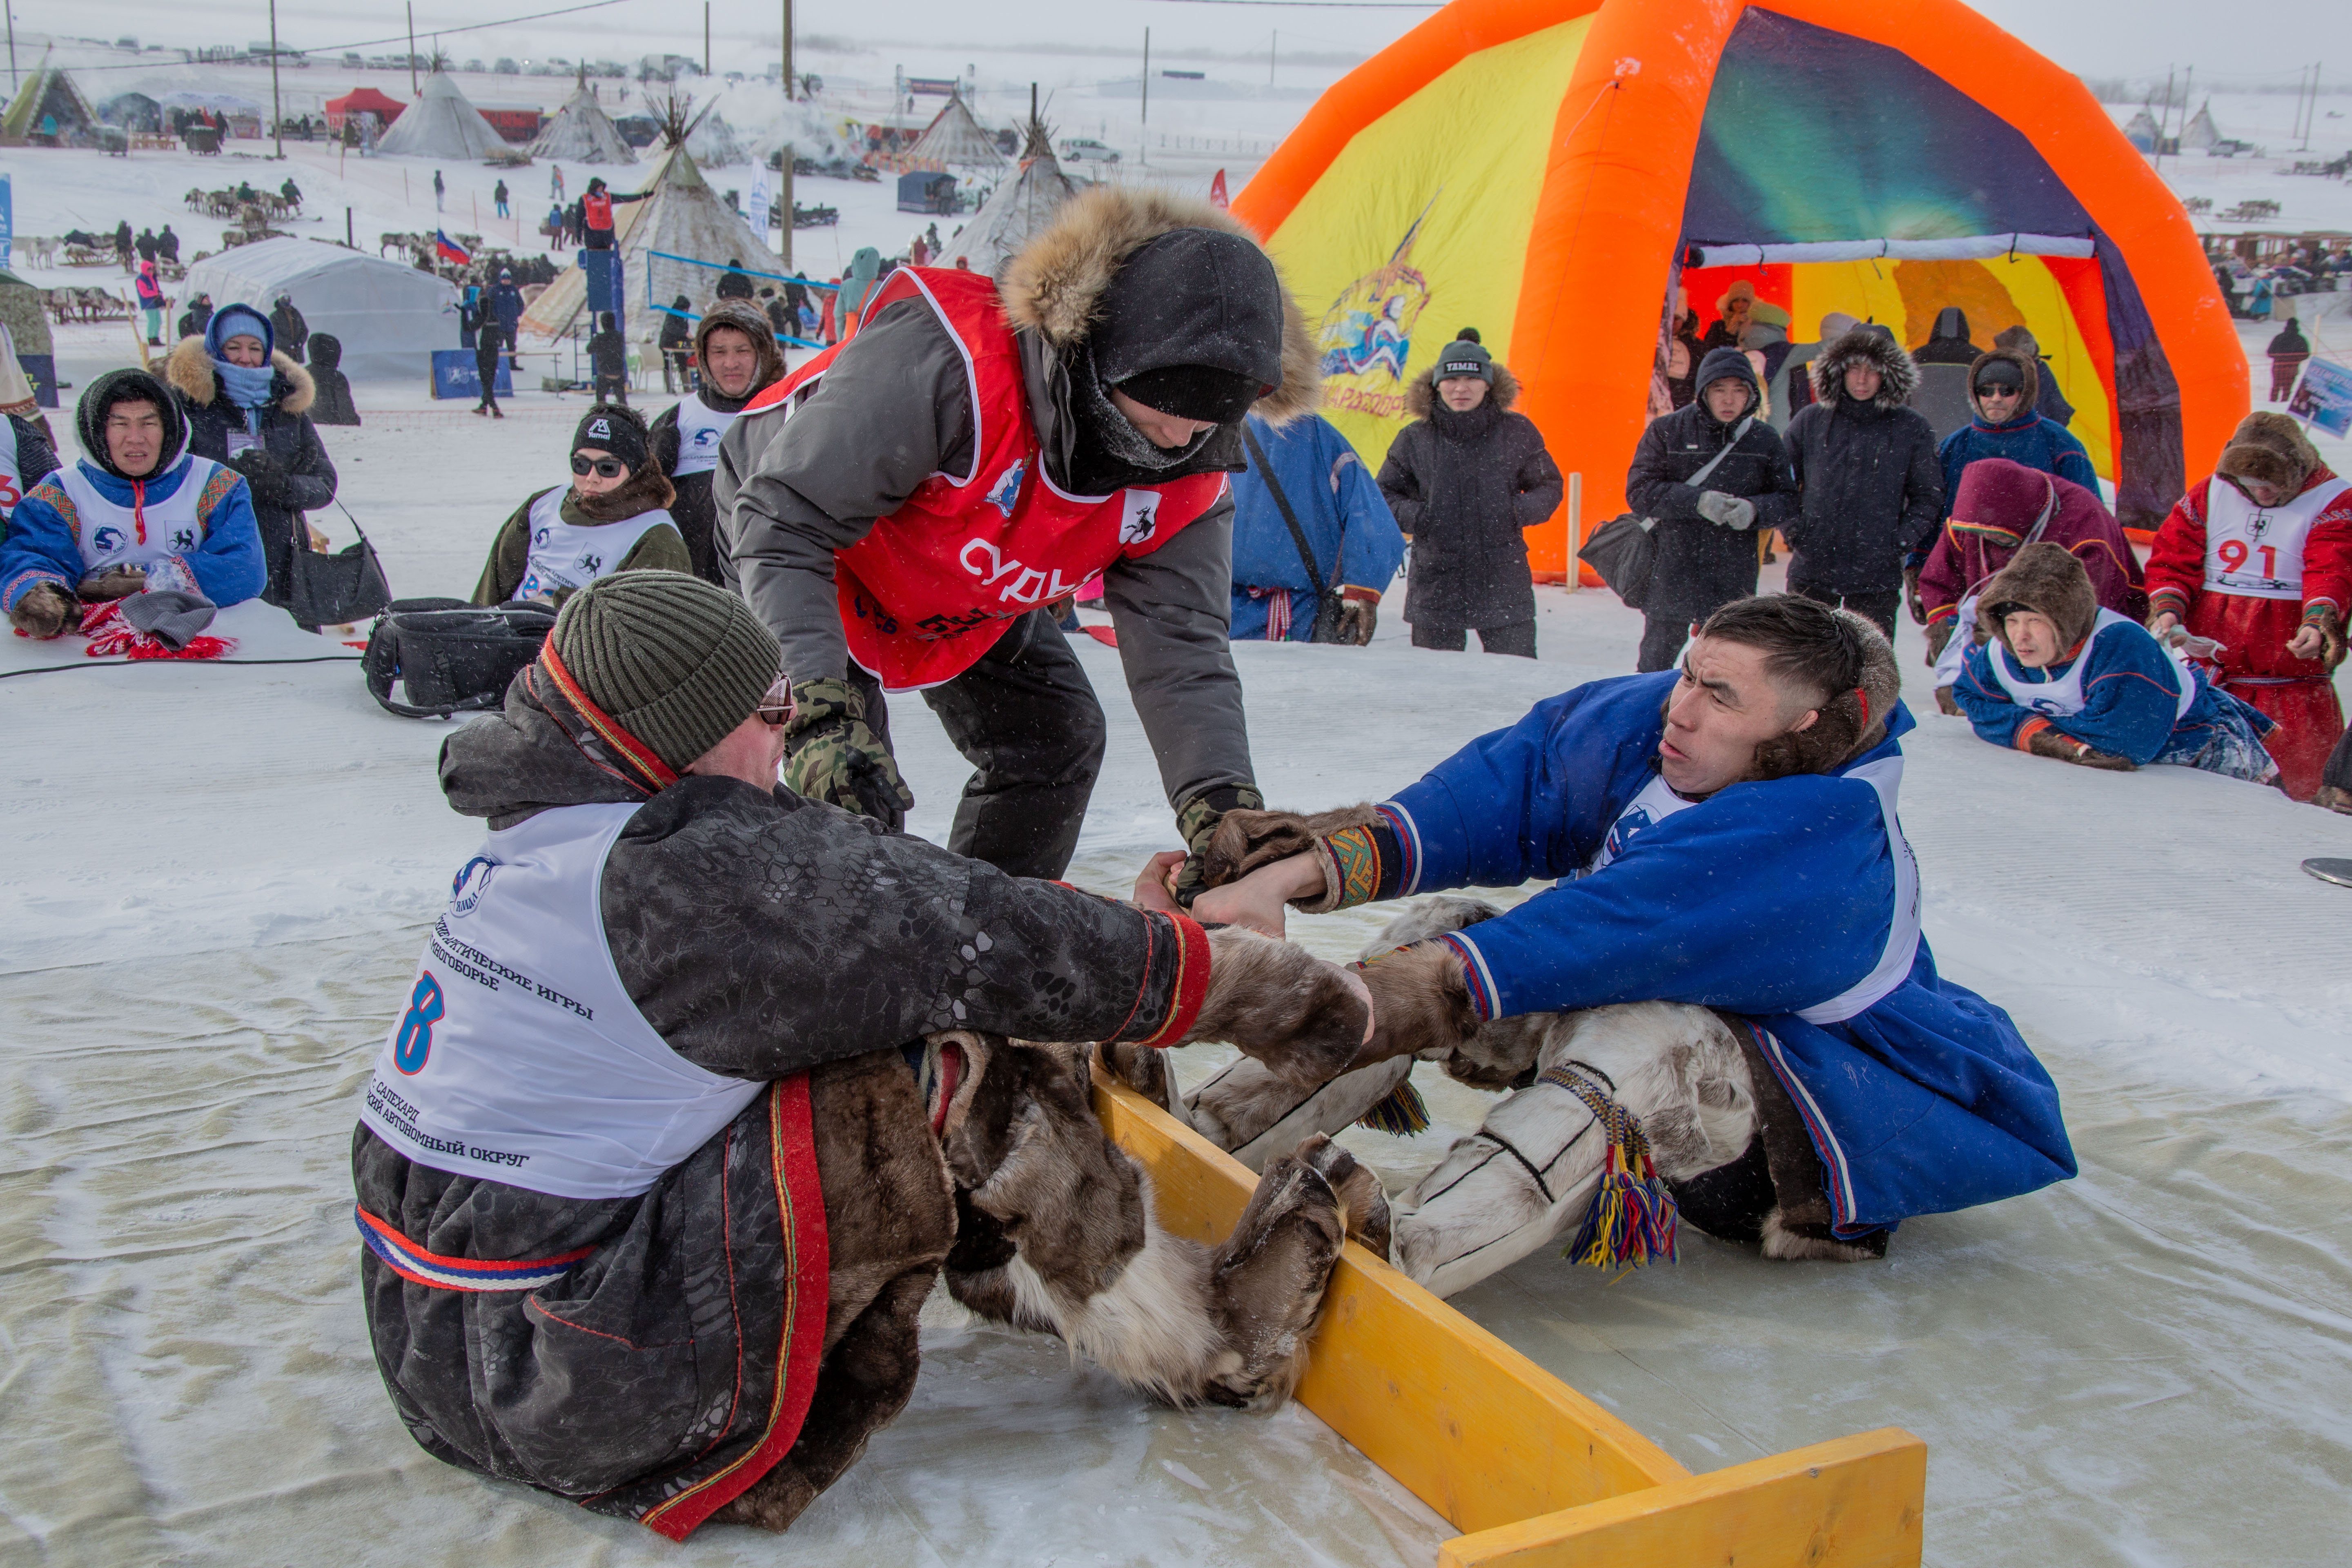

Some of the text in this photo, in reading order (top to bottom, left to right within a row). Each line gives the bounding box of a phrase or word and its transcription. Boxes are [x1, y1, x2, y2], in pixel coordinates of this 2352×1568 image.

[1446, 362, 1479, 372] YAMAL
[588, 431, 610, 440] Yamal
[2218, 539, 2276, 580] 91
[431, 938, 500, 991] МНОГОБОРЬЕ
[442, 937, 532, 991] АРКТИЧЕСКИЕ
[537, 983, 594, 1021] ИГРЫ
[394, 970, 445, 1076] 8
[376, 1081, 420, 1124] САЛЕХАРД
[382, 1108, 466, 1156] АВТОНОМНЫЙ
[470, 1147, 530, 1167] ОКРУГ
